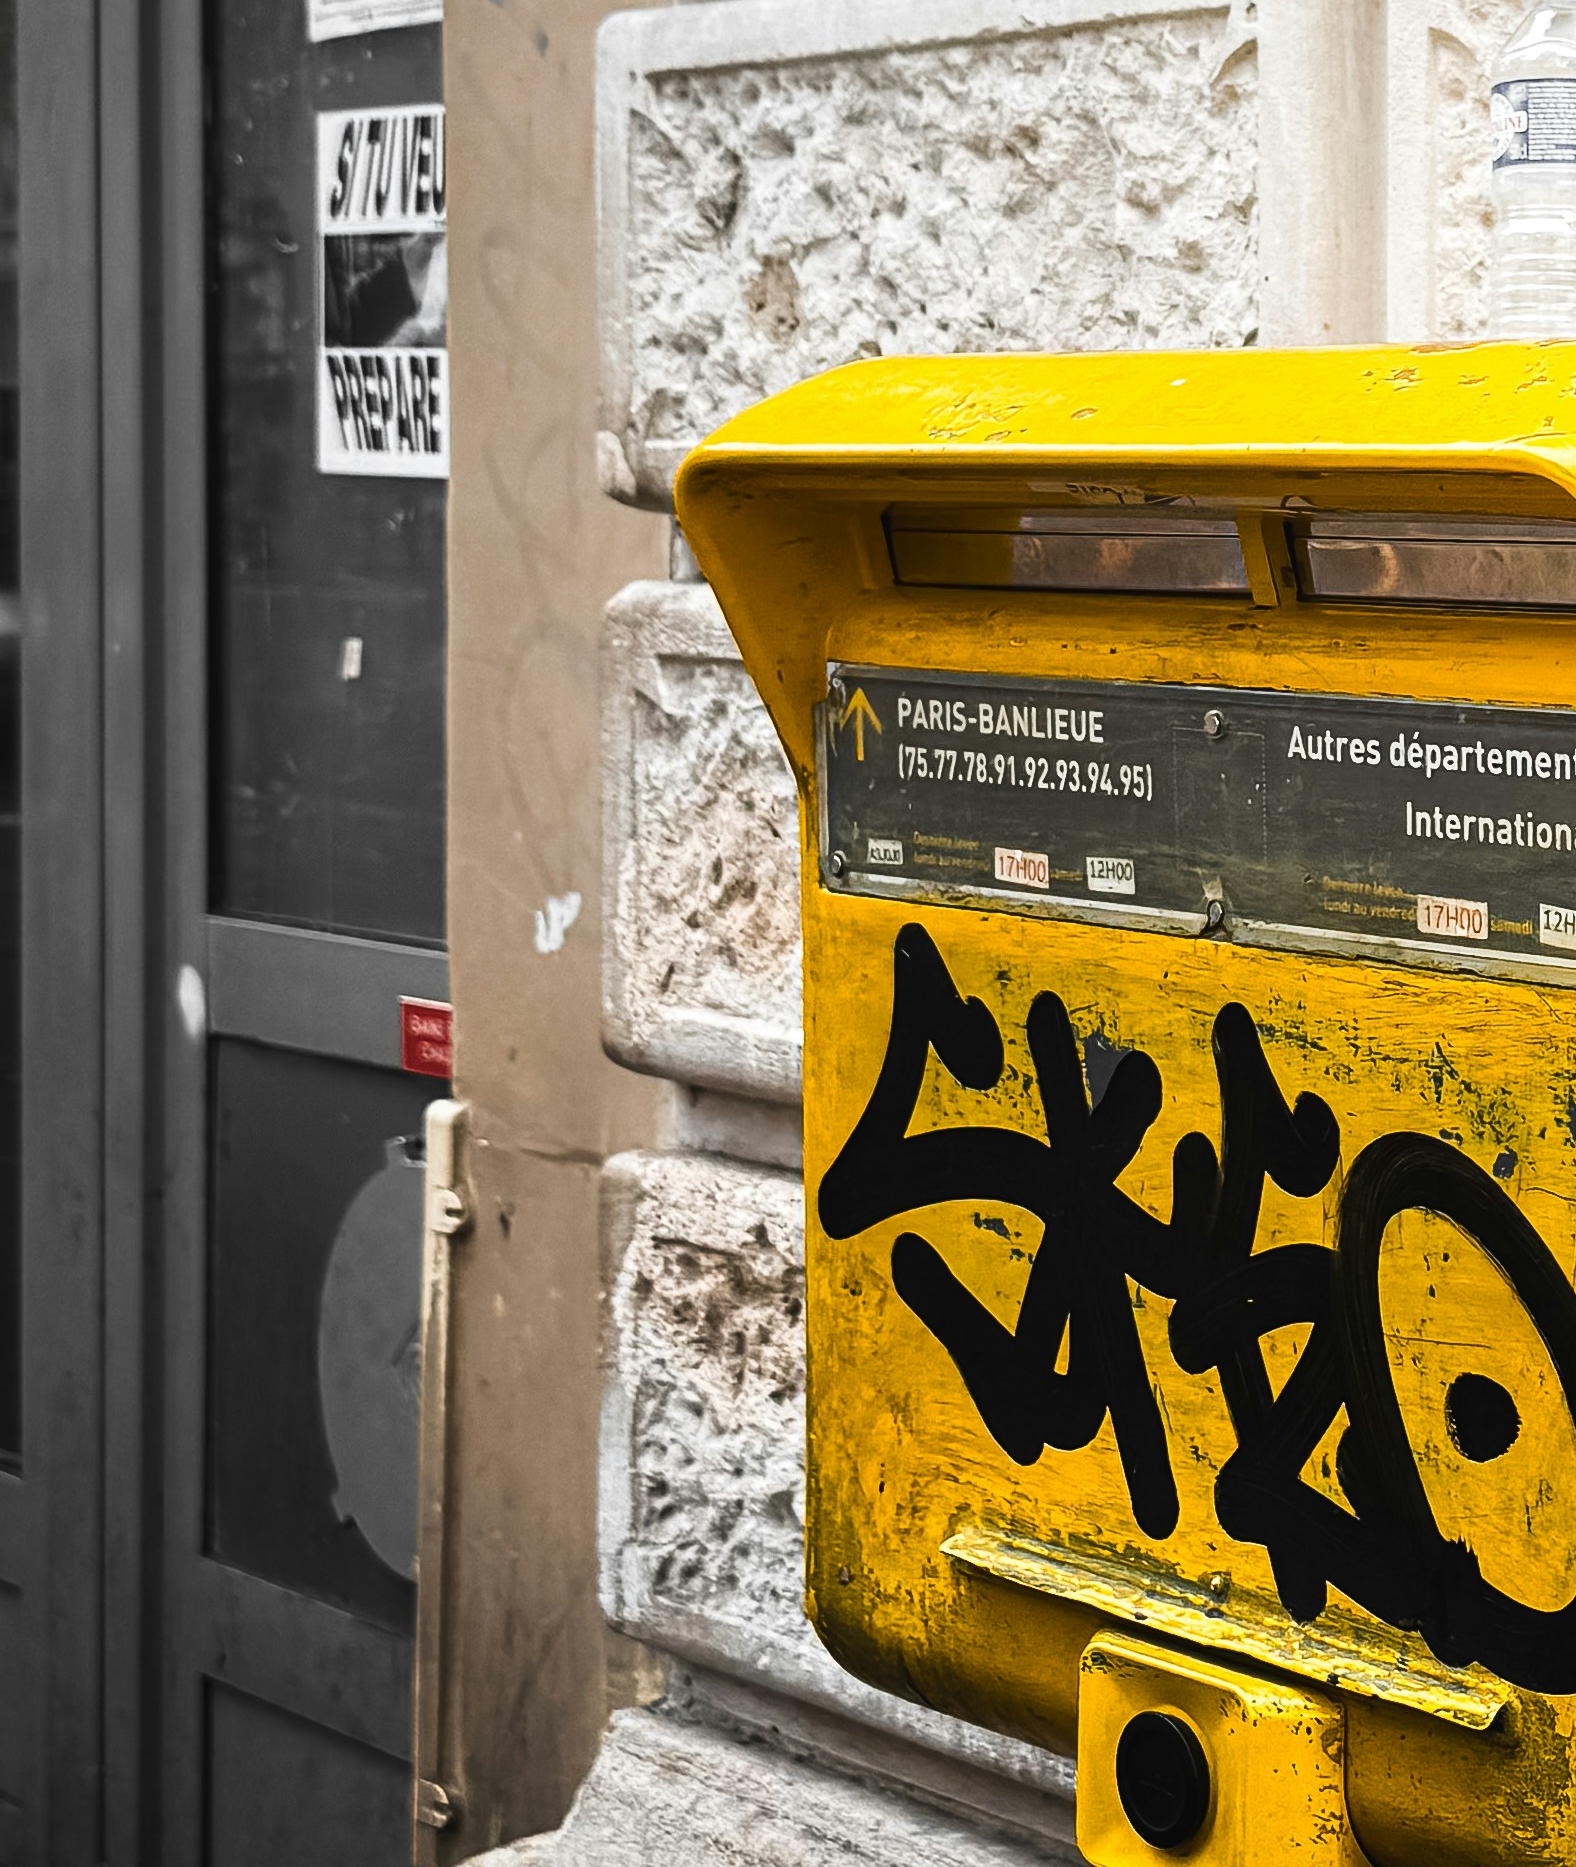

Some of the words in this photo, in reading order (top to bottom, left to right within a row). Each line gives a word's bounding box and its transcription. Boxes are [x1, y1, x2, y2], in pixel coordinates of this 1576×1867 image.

[330, 119, 363, 218] SI
[361, 116, 398, 217] TU
[327, 354, 441, 454] PREPARE
[897, 697, 1104, 744] PARIS-BANLIEUE
[1287, 725, 1381, 765] Autres
[898, 743, 1152, 802] (75.77.78.91.92.93.94.95)
[999, 855, 1047, 883] 17H00
[1090, 860, 1133, 882] 12H00
[1423, 903, 1483, 935] 17H00
